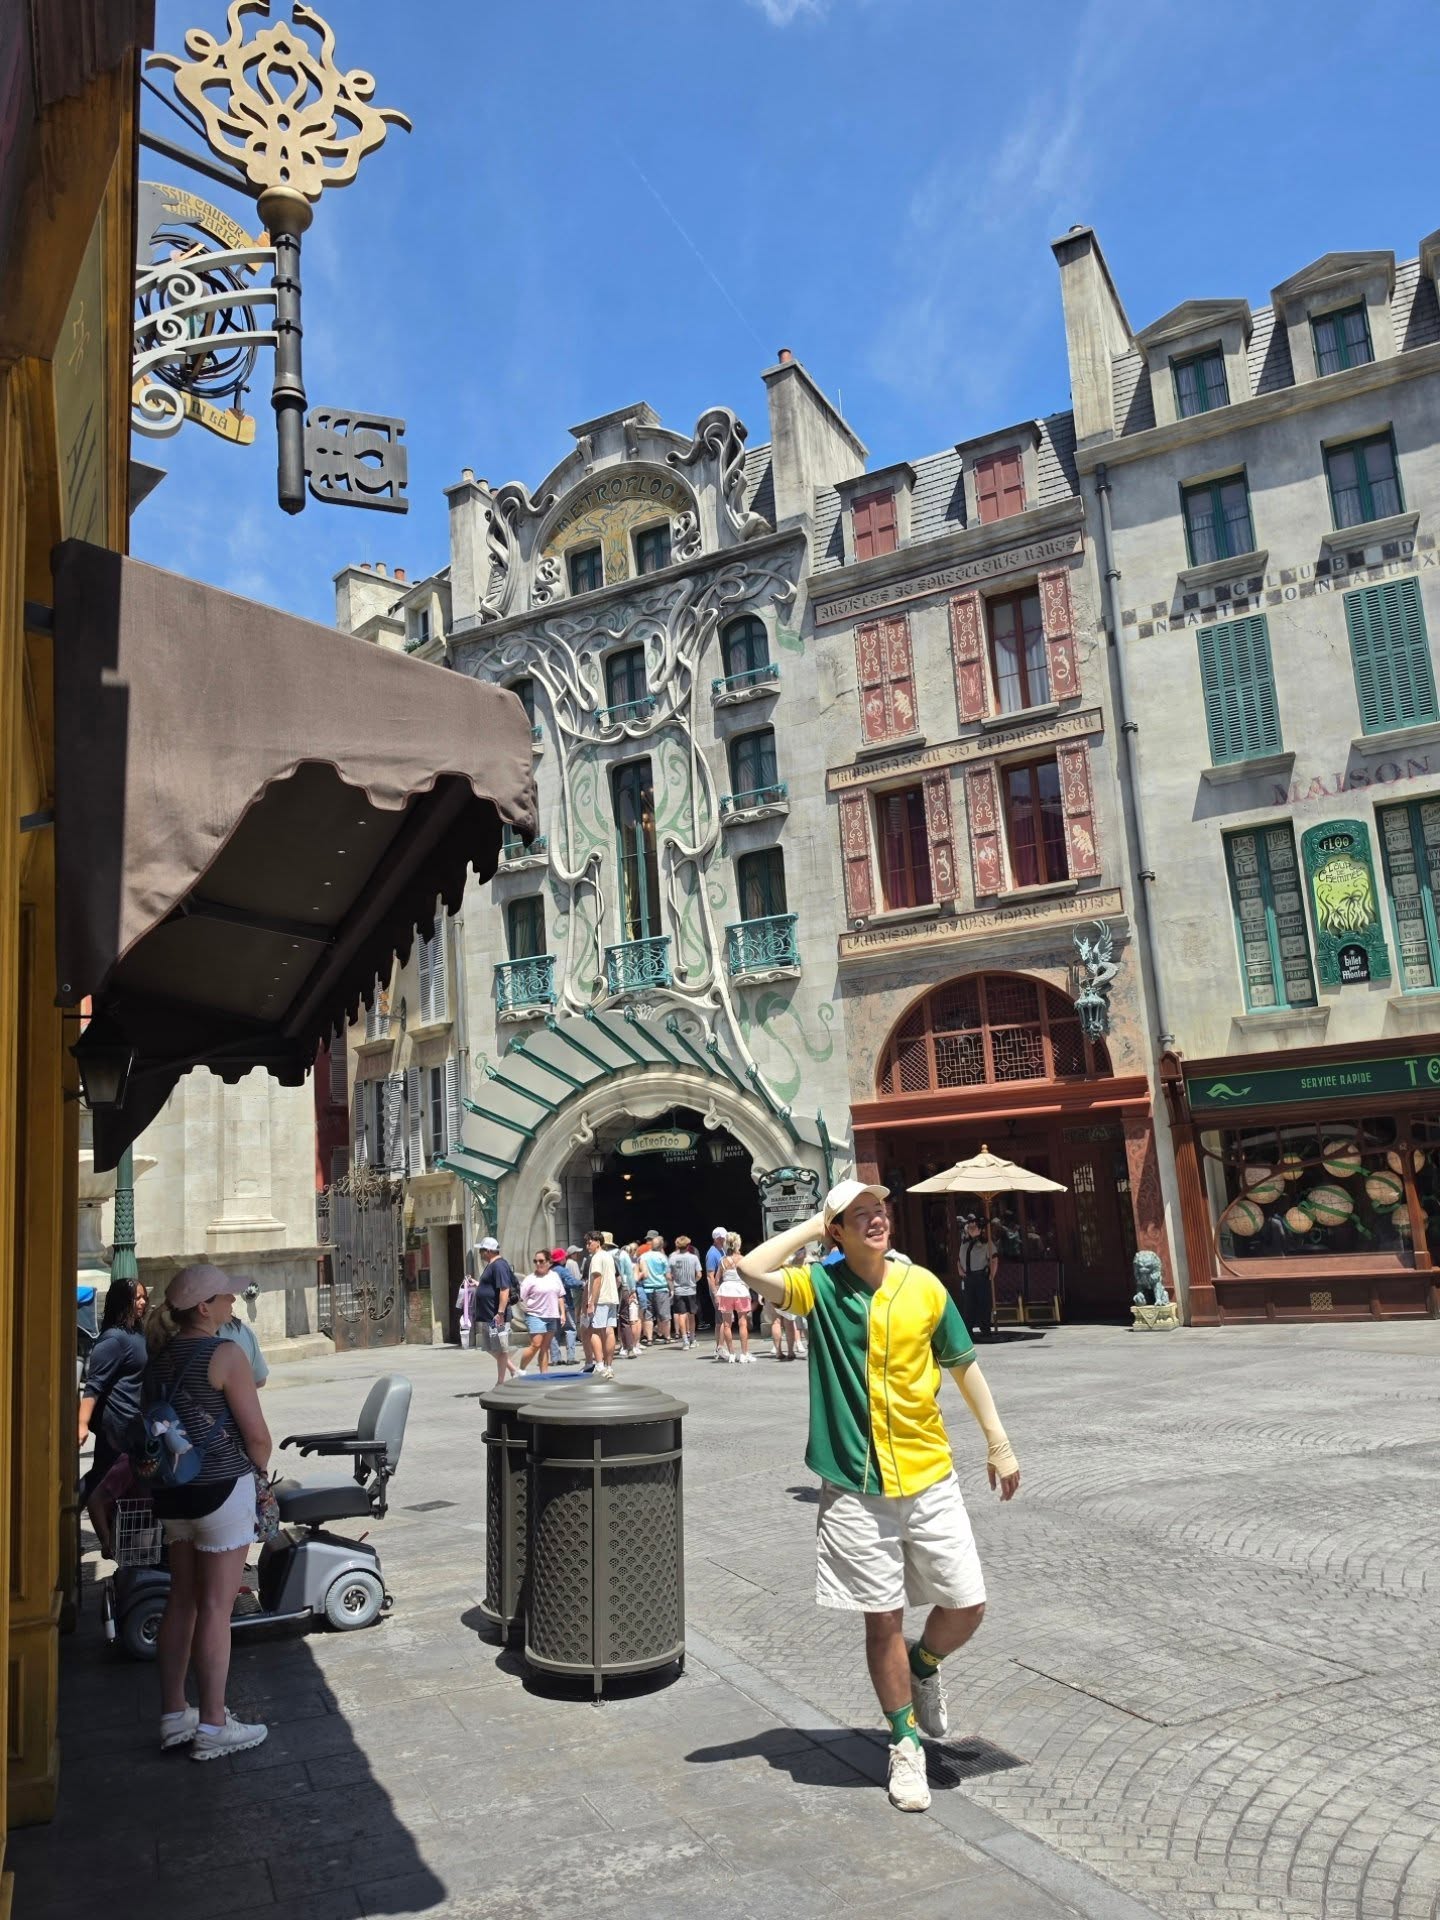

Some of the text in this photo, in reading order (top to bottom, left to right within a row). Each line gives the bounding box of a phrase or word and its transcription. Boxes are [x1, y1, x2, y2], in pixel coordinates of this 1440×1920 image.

[195, 198, 244, 238] CAUSER
[1233, 557, 1345, 596] CLUB
[1272, 755, 1430, 806] MAISON
[1323, 836, 1350, 850] FLOO
[1301, 1072, 1372, 1089] SERVICE RAPIDE
[631, 1136, 679, 1150] METROFLOO
[666, 1155, 696, 1163] ENTRANCE
